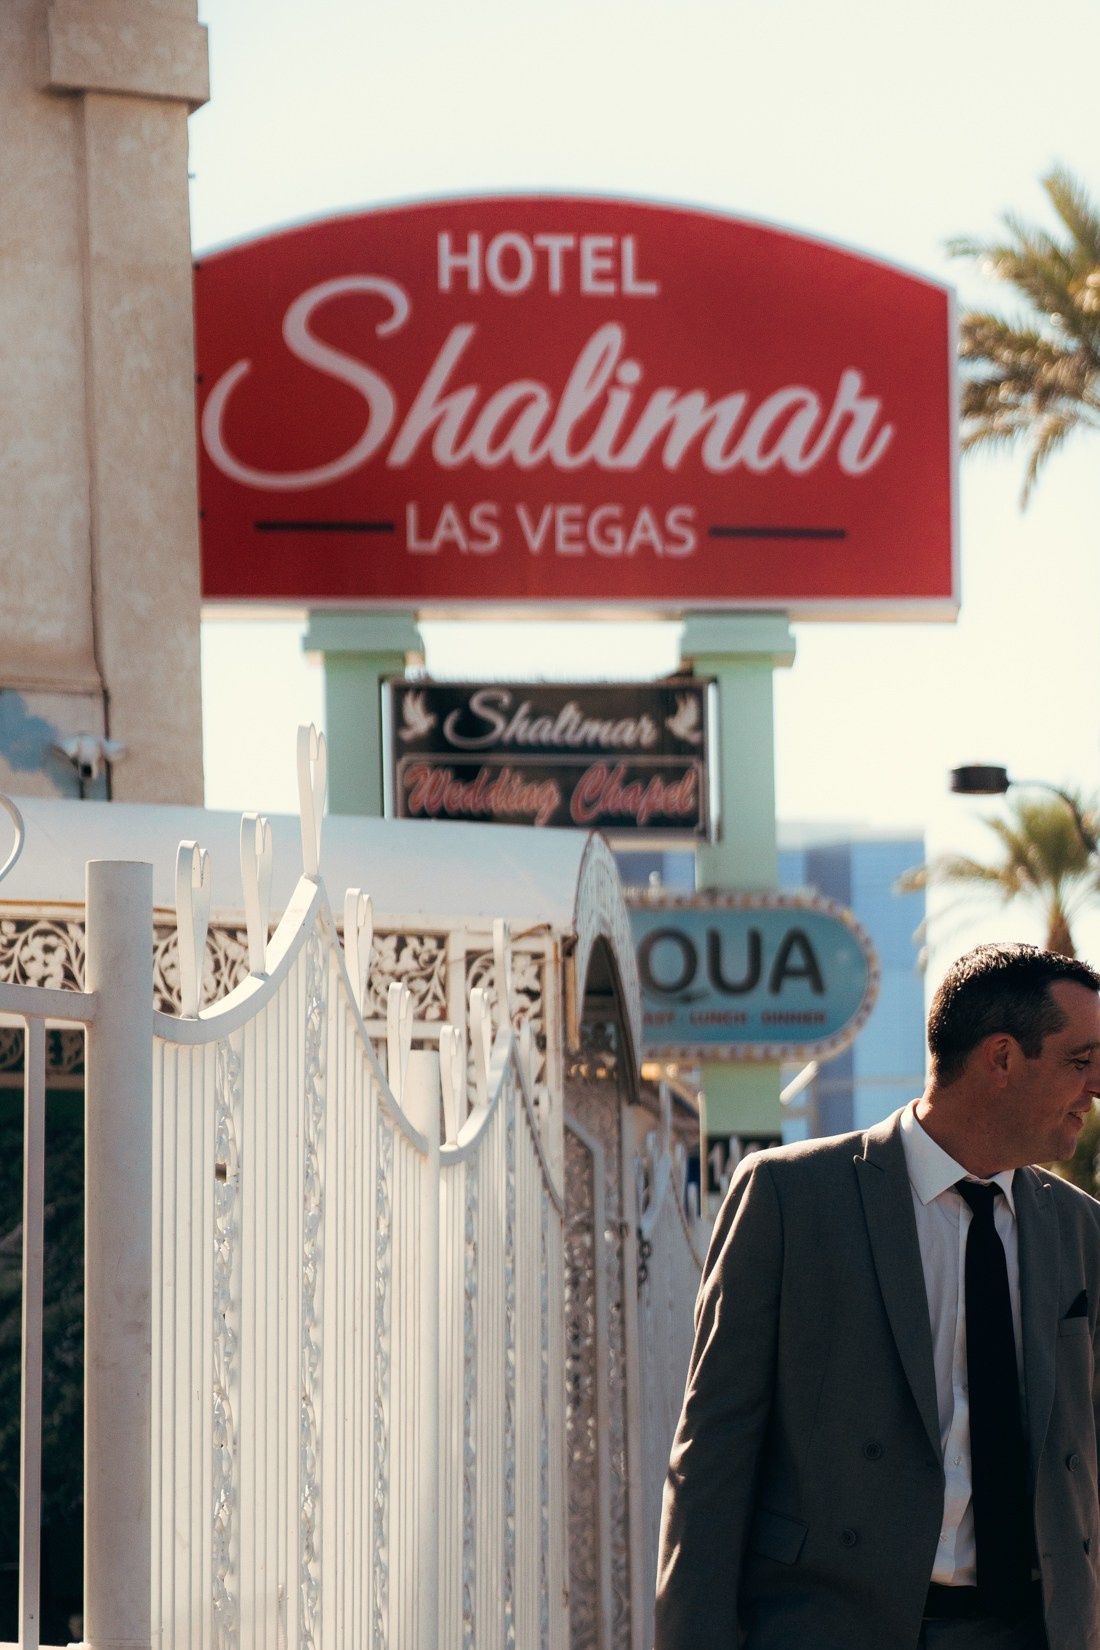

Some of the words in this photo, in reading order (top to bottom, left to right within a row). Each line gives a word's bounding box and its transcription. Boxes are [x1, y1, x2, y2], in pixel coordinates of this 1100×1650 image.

[437, 231, 660, 295] HOTEL
[201, 275, 895, 492] Shalimar
[405, 503, 501, 555] LAS
[517, 505, 698, 557] VEGAS
[443, 687, 658, 750] Shalimar
[403, 762, 561, 827] Wedding
[569, 758, 700, 825] Chapel
[638, 926, 827, 1006] QUA
